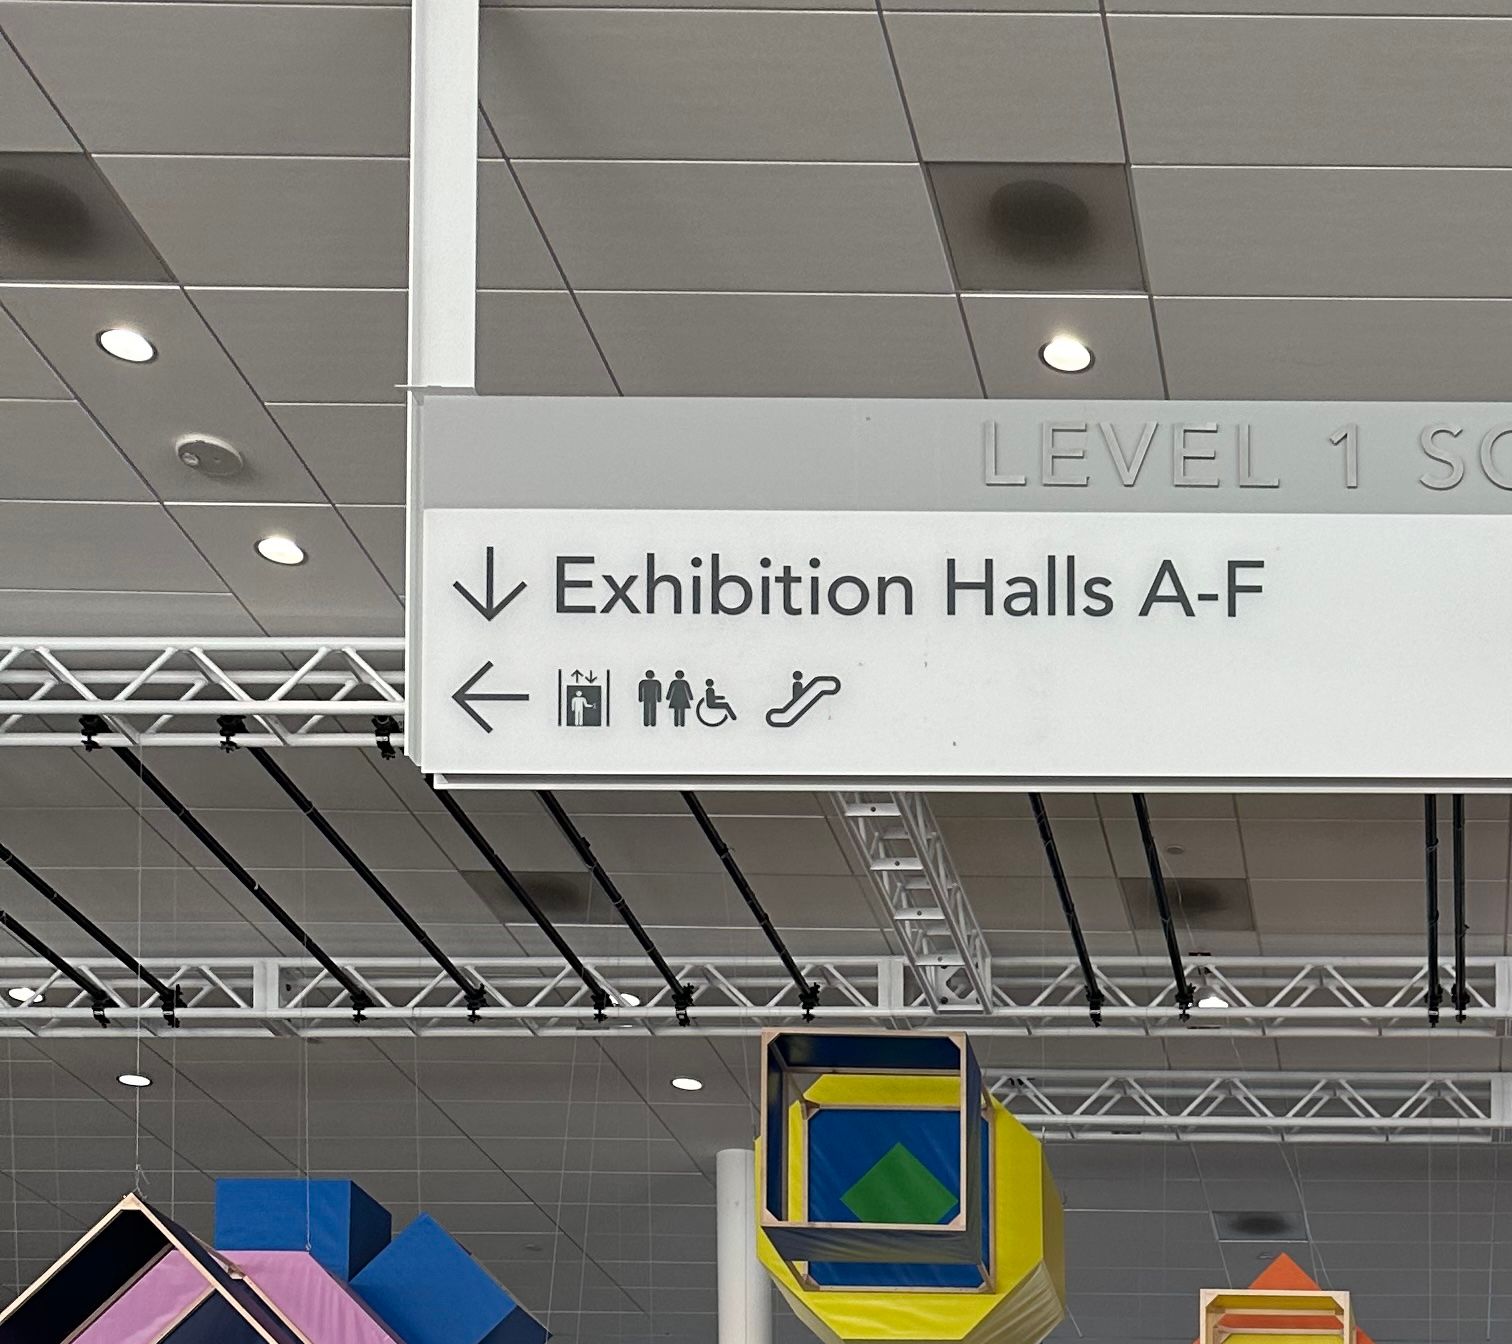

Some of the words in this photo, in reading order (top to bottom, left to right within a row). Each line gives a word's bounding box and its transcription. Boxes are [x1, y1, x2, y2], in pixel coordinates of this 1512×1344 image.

[980, 420, 1281, 491] LEVEL
[1327, 420, 1362, 491] 1
[556, 553, 912, 616] Exhibition
[947, 555, 1113, 617] Halls
[1139, 560, 1264, 617] A-F
